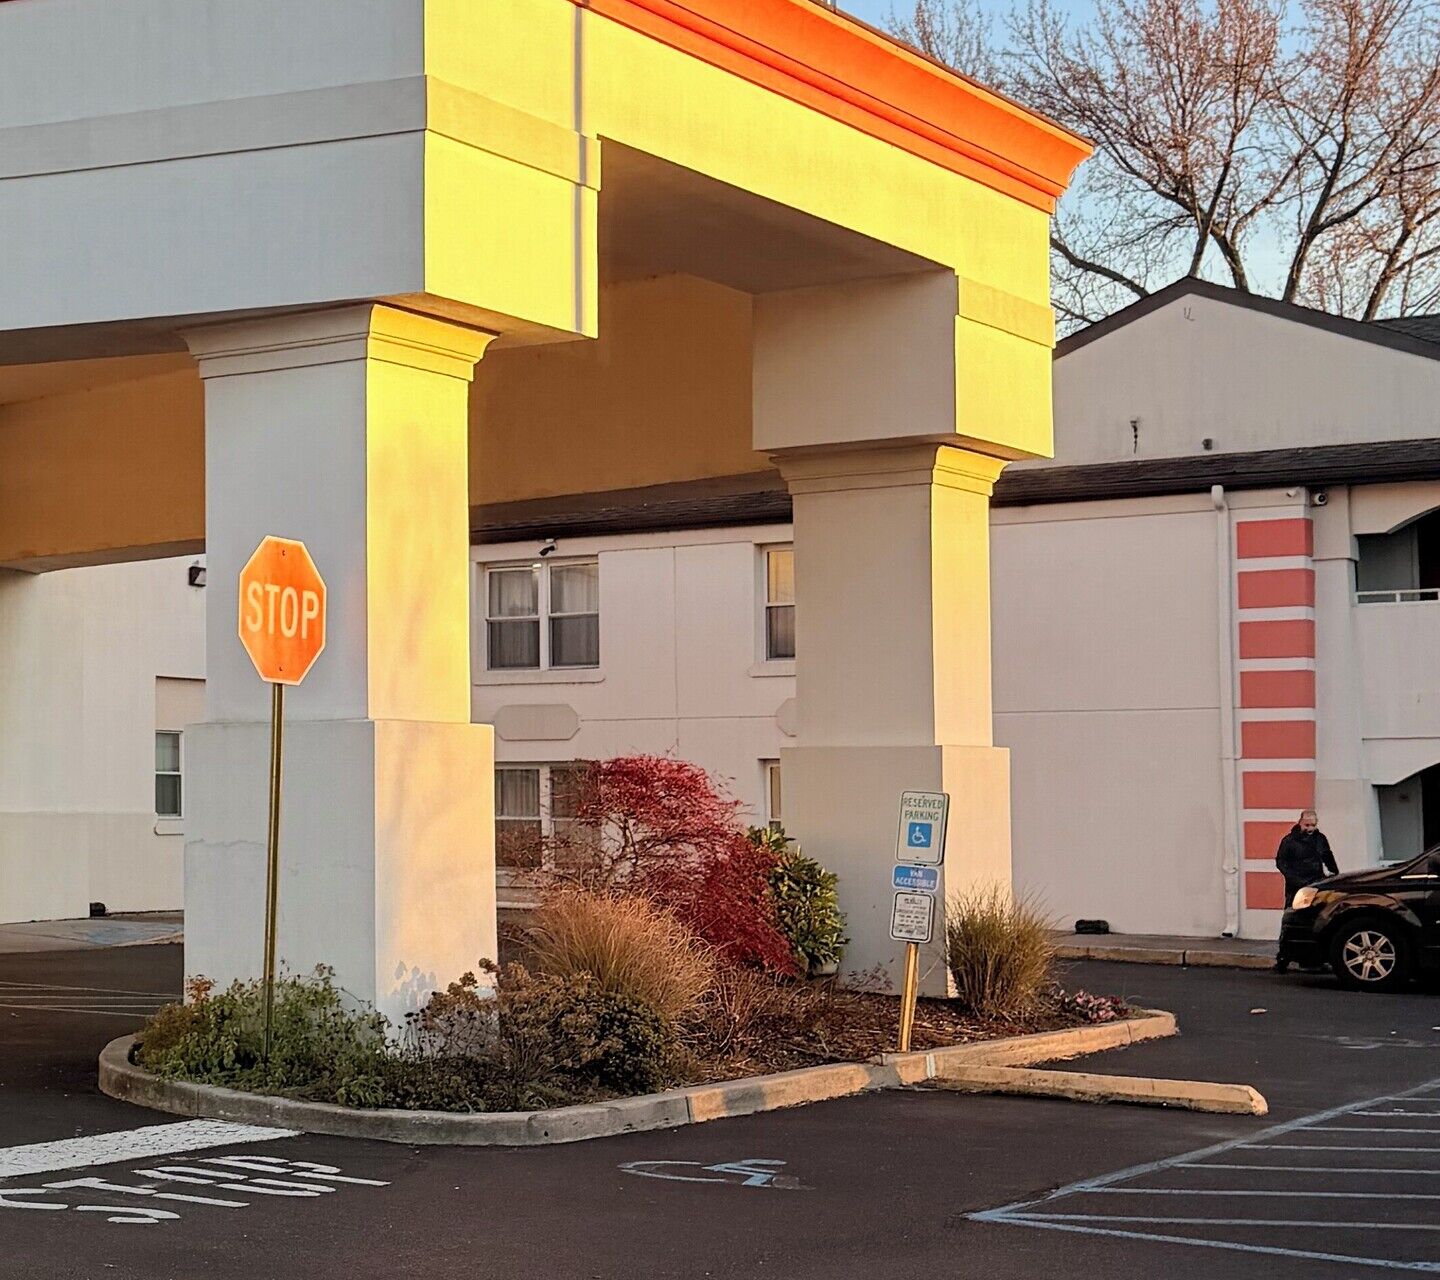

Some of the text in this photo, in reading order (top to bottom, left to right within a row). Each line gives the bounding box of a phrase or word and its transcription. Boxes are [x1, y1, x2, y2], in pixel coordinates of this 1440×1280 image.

[246, 580, 320, 640] STOP
[902, 797, 943, 810] RESERVED
[904, 810, 939, 822] PARKING
[895, 877, 935, 889] ACCESSIBLE
